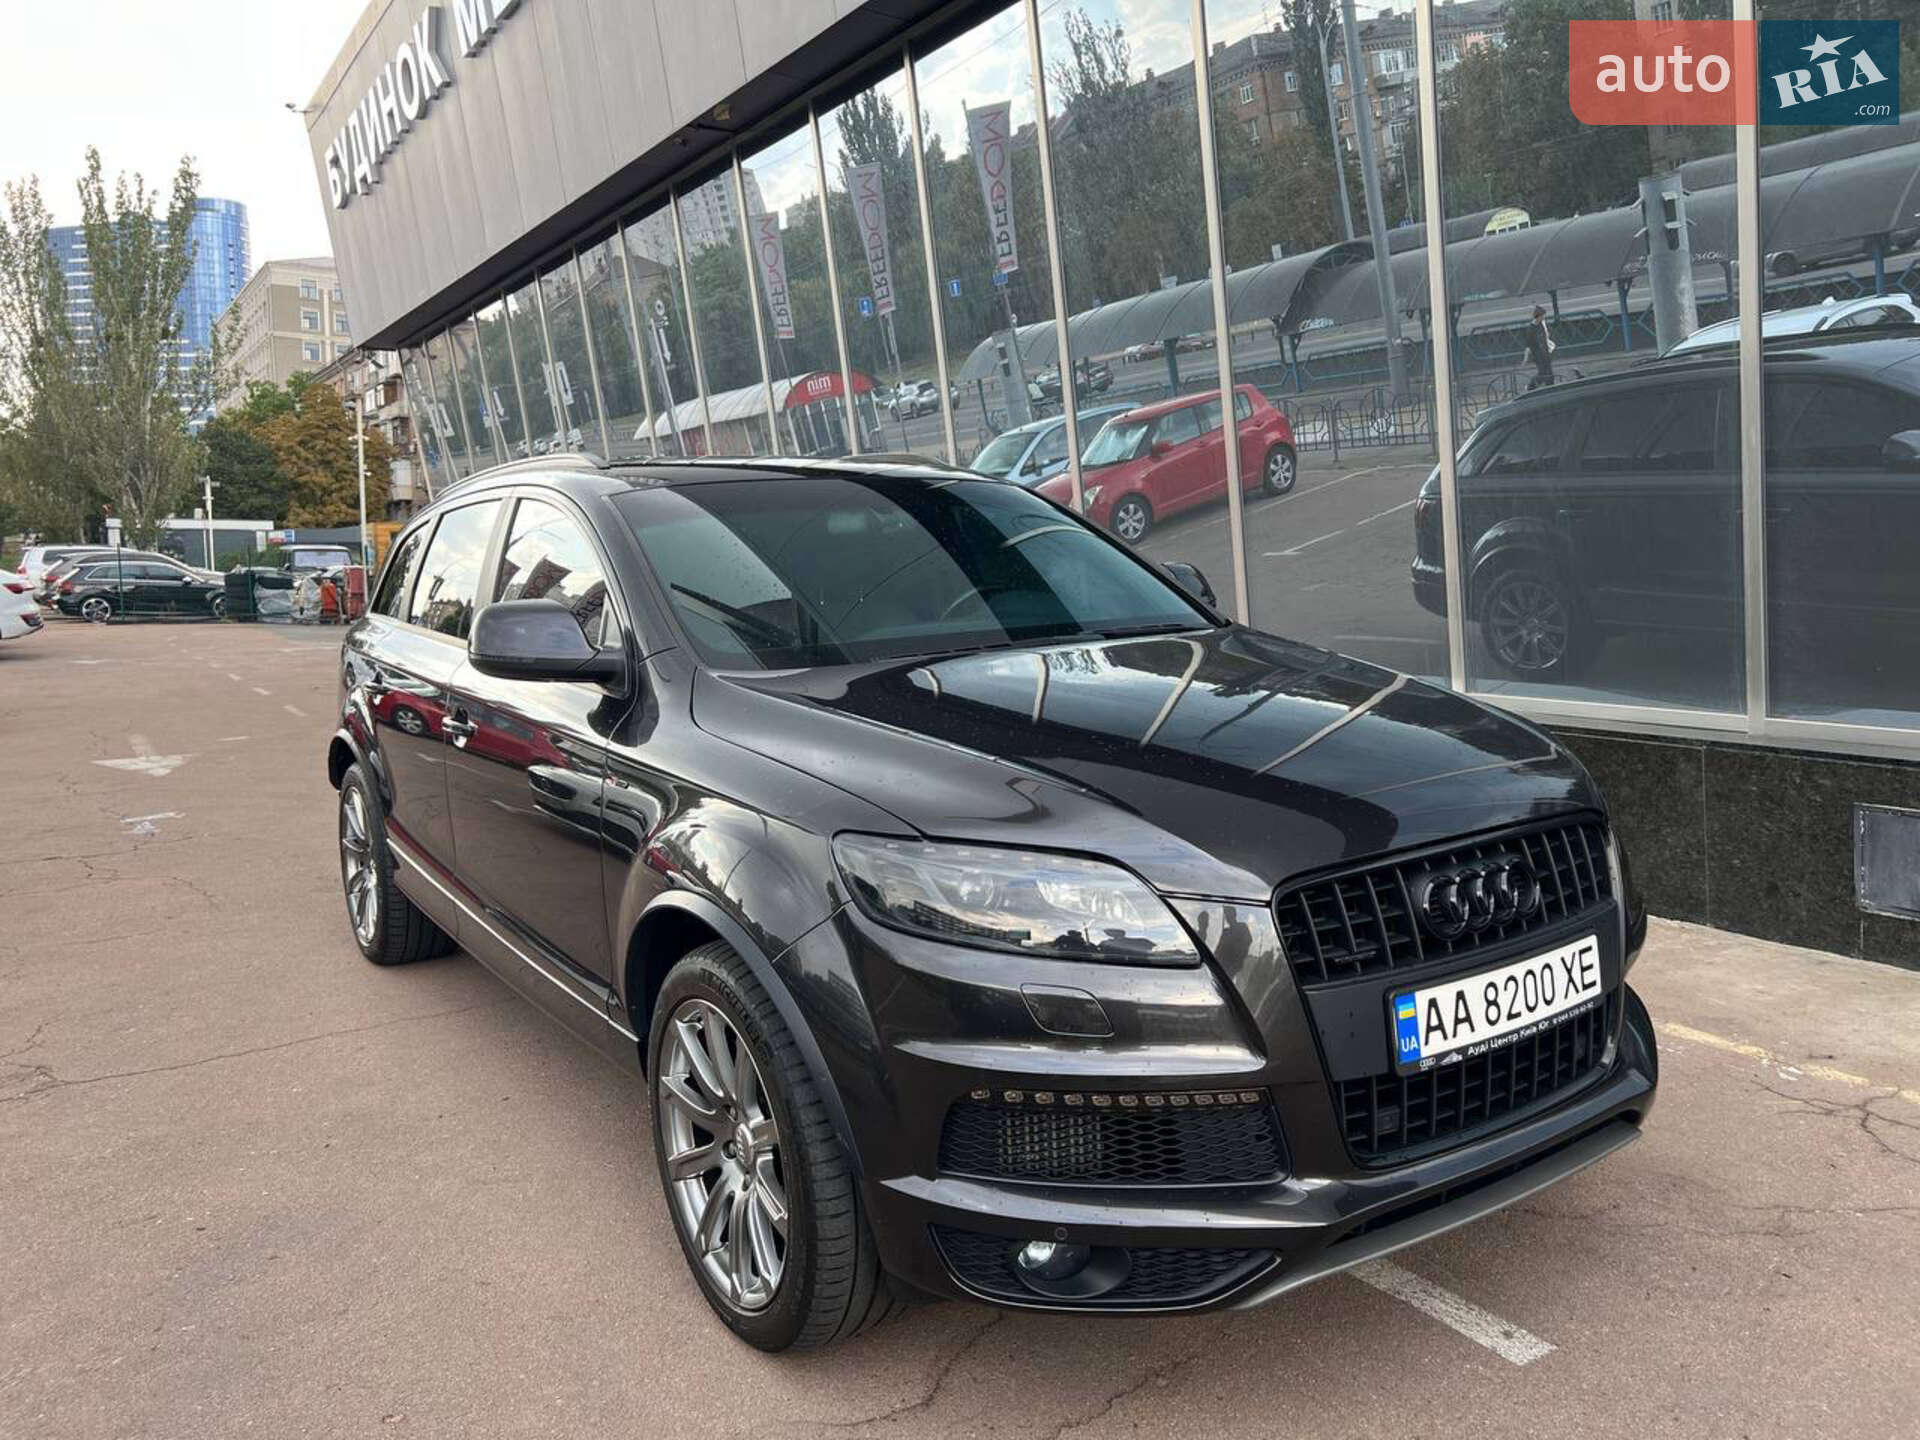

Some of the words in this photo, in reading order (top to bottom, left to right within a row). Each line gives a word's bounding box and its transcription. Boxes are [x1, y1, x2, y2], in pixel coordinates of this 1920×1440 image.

[325, 5, 452, 209] БУДИНОК
[1401, 1036, 1419, 1052] UA
[1424, 989, 1475, 1046] AA
[1484, 962, 1555, 1026] 8200
[1561, 945, 1597, 1000] XE
